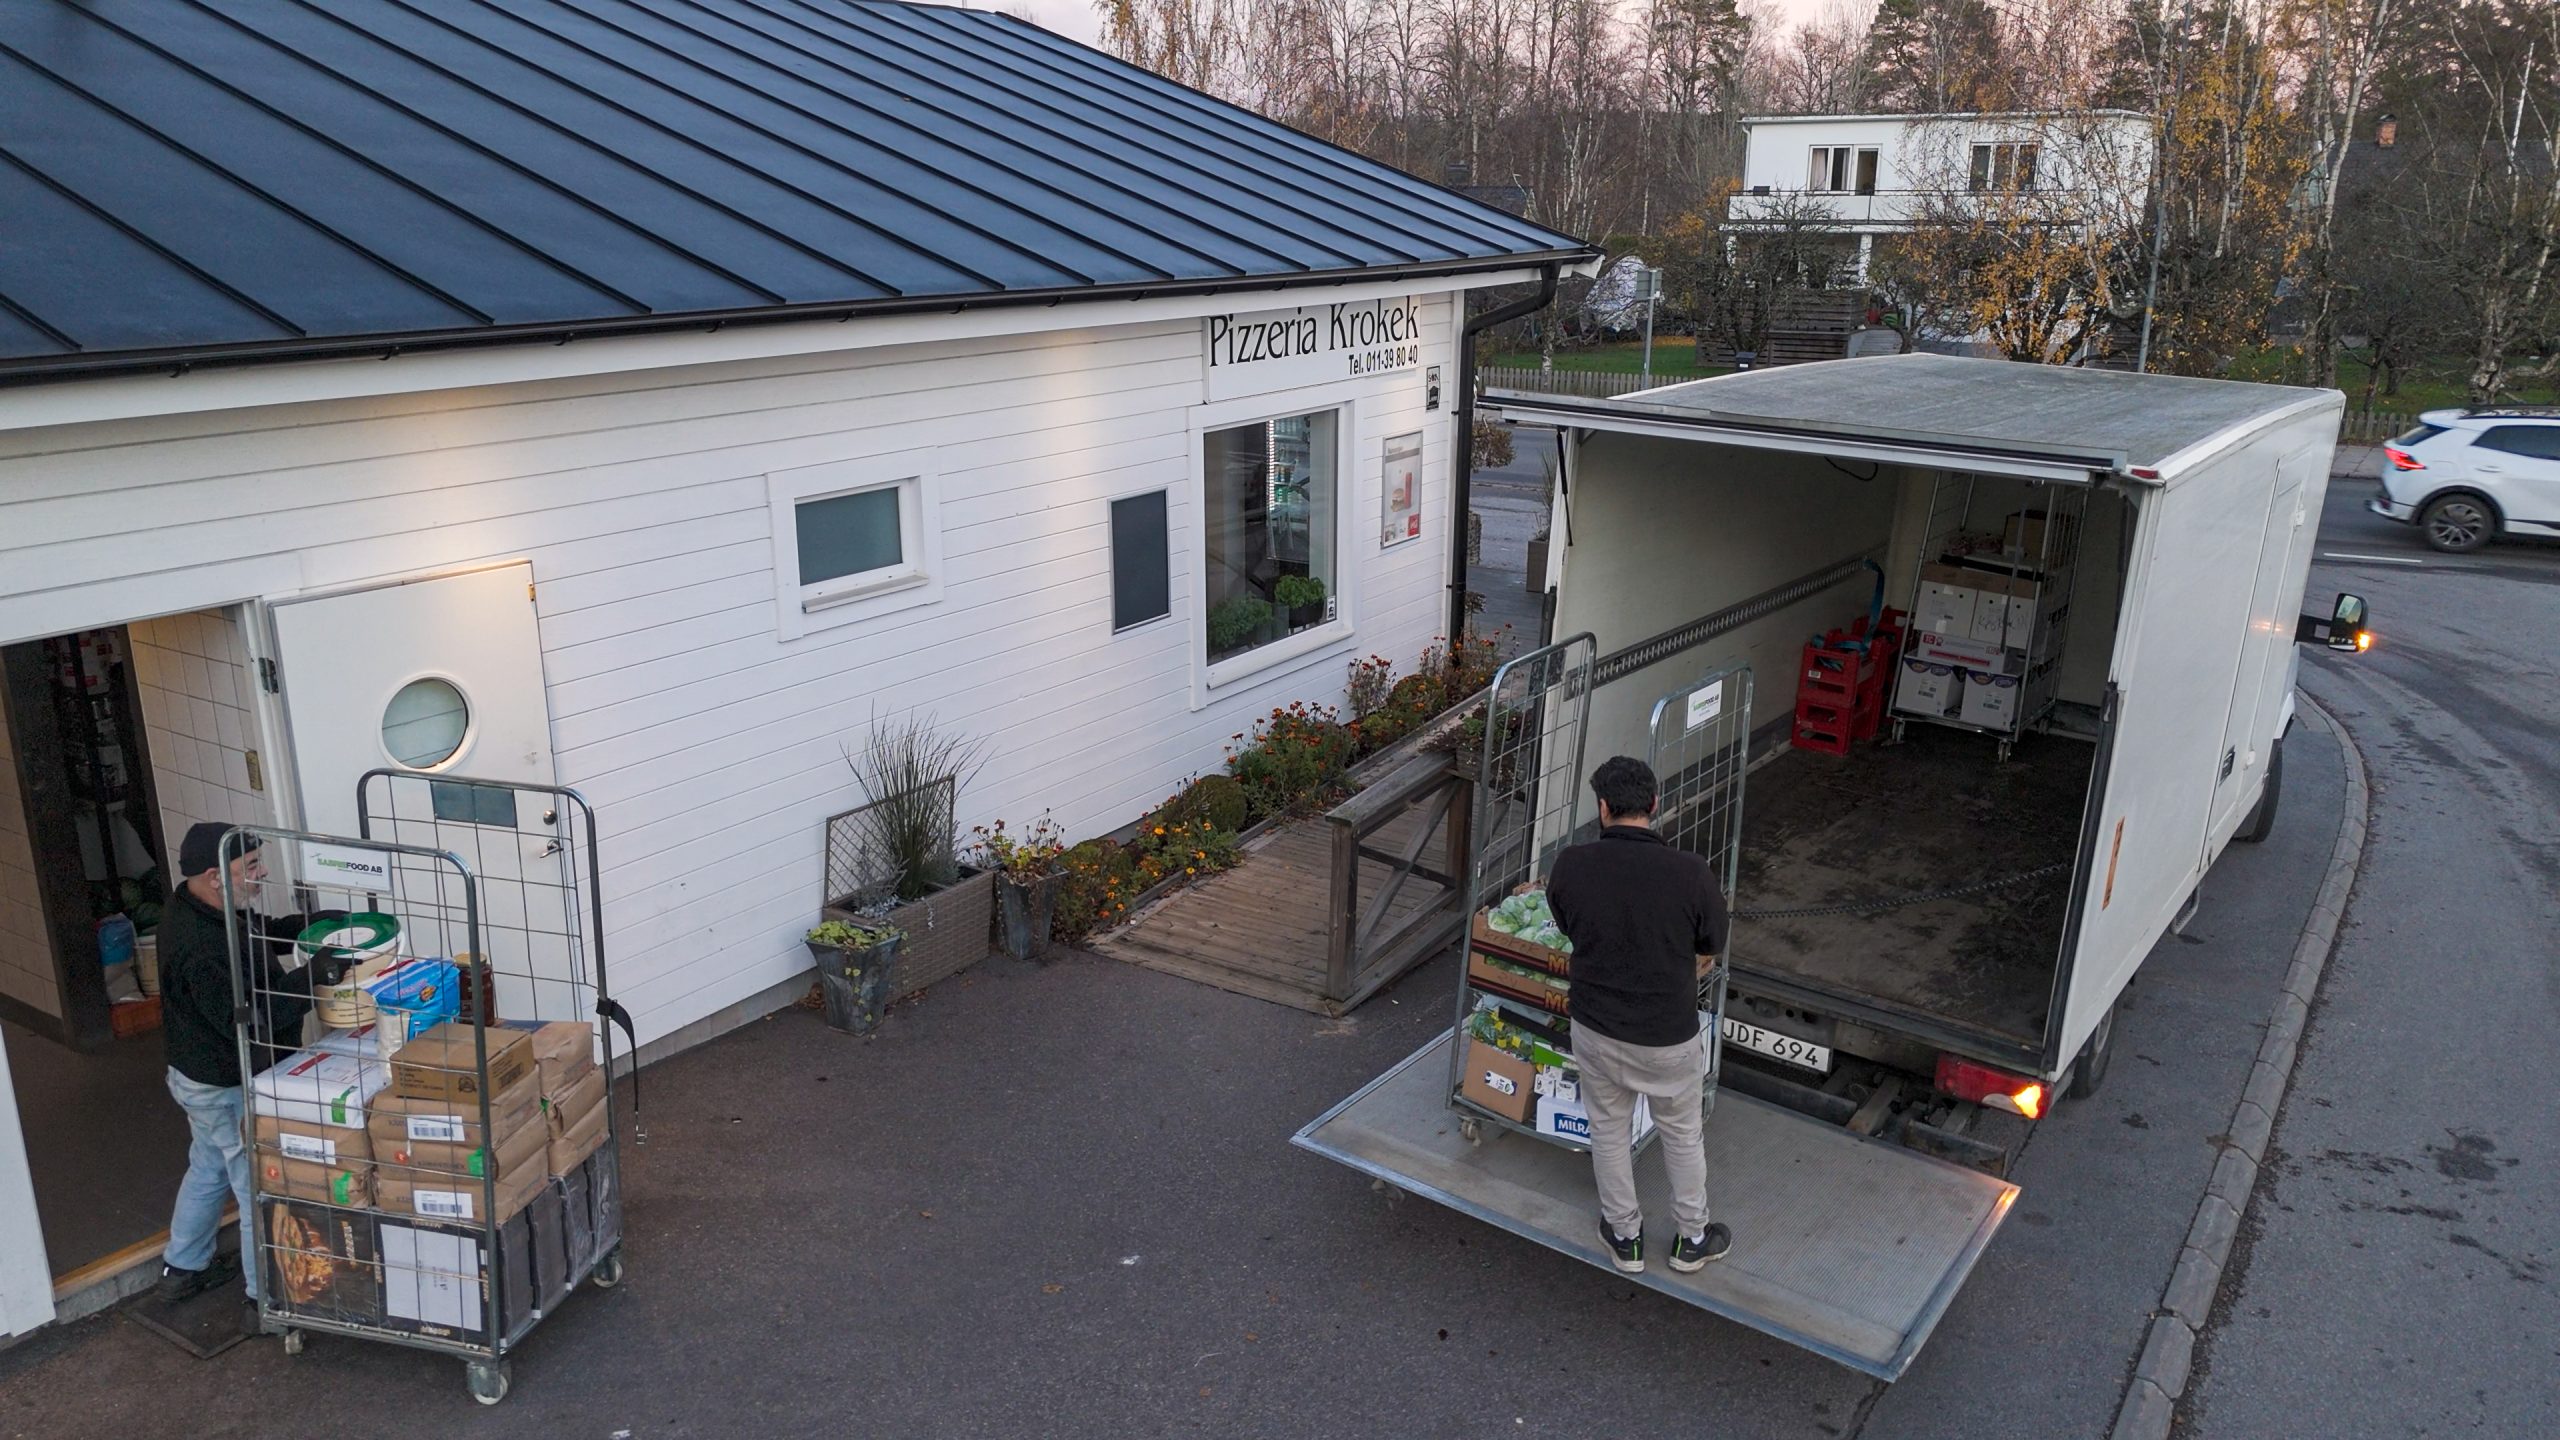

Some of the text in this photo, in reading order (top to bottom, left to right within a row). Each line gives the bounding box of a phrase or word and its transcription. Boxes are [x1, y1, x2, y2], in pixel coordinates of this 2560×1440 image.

[1208, 295, 1419, 367] Pizzeria Krokek
[1348, 343, 1418, 375] Tel. 011-39 80 40
[370, 865, 383, 874] AB
[1722, 1021, 1818, 1066] JDF 694
